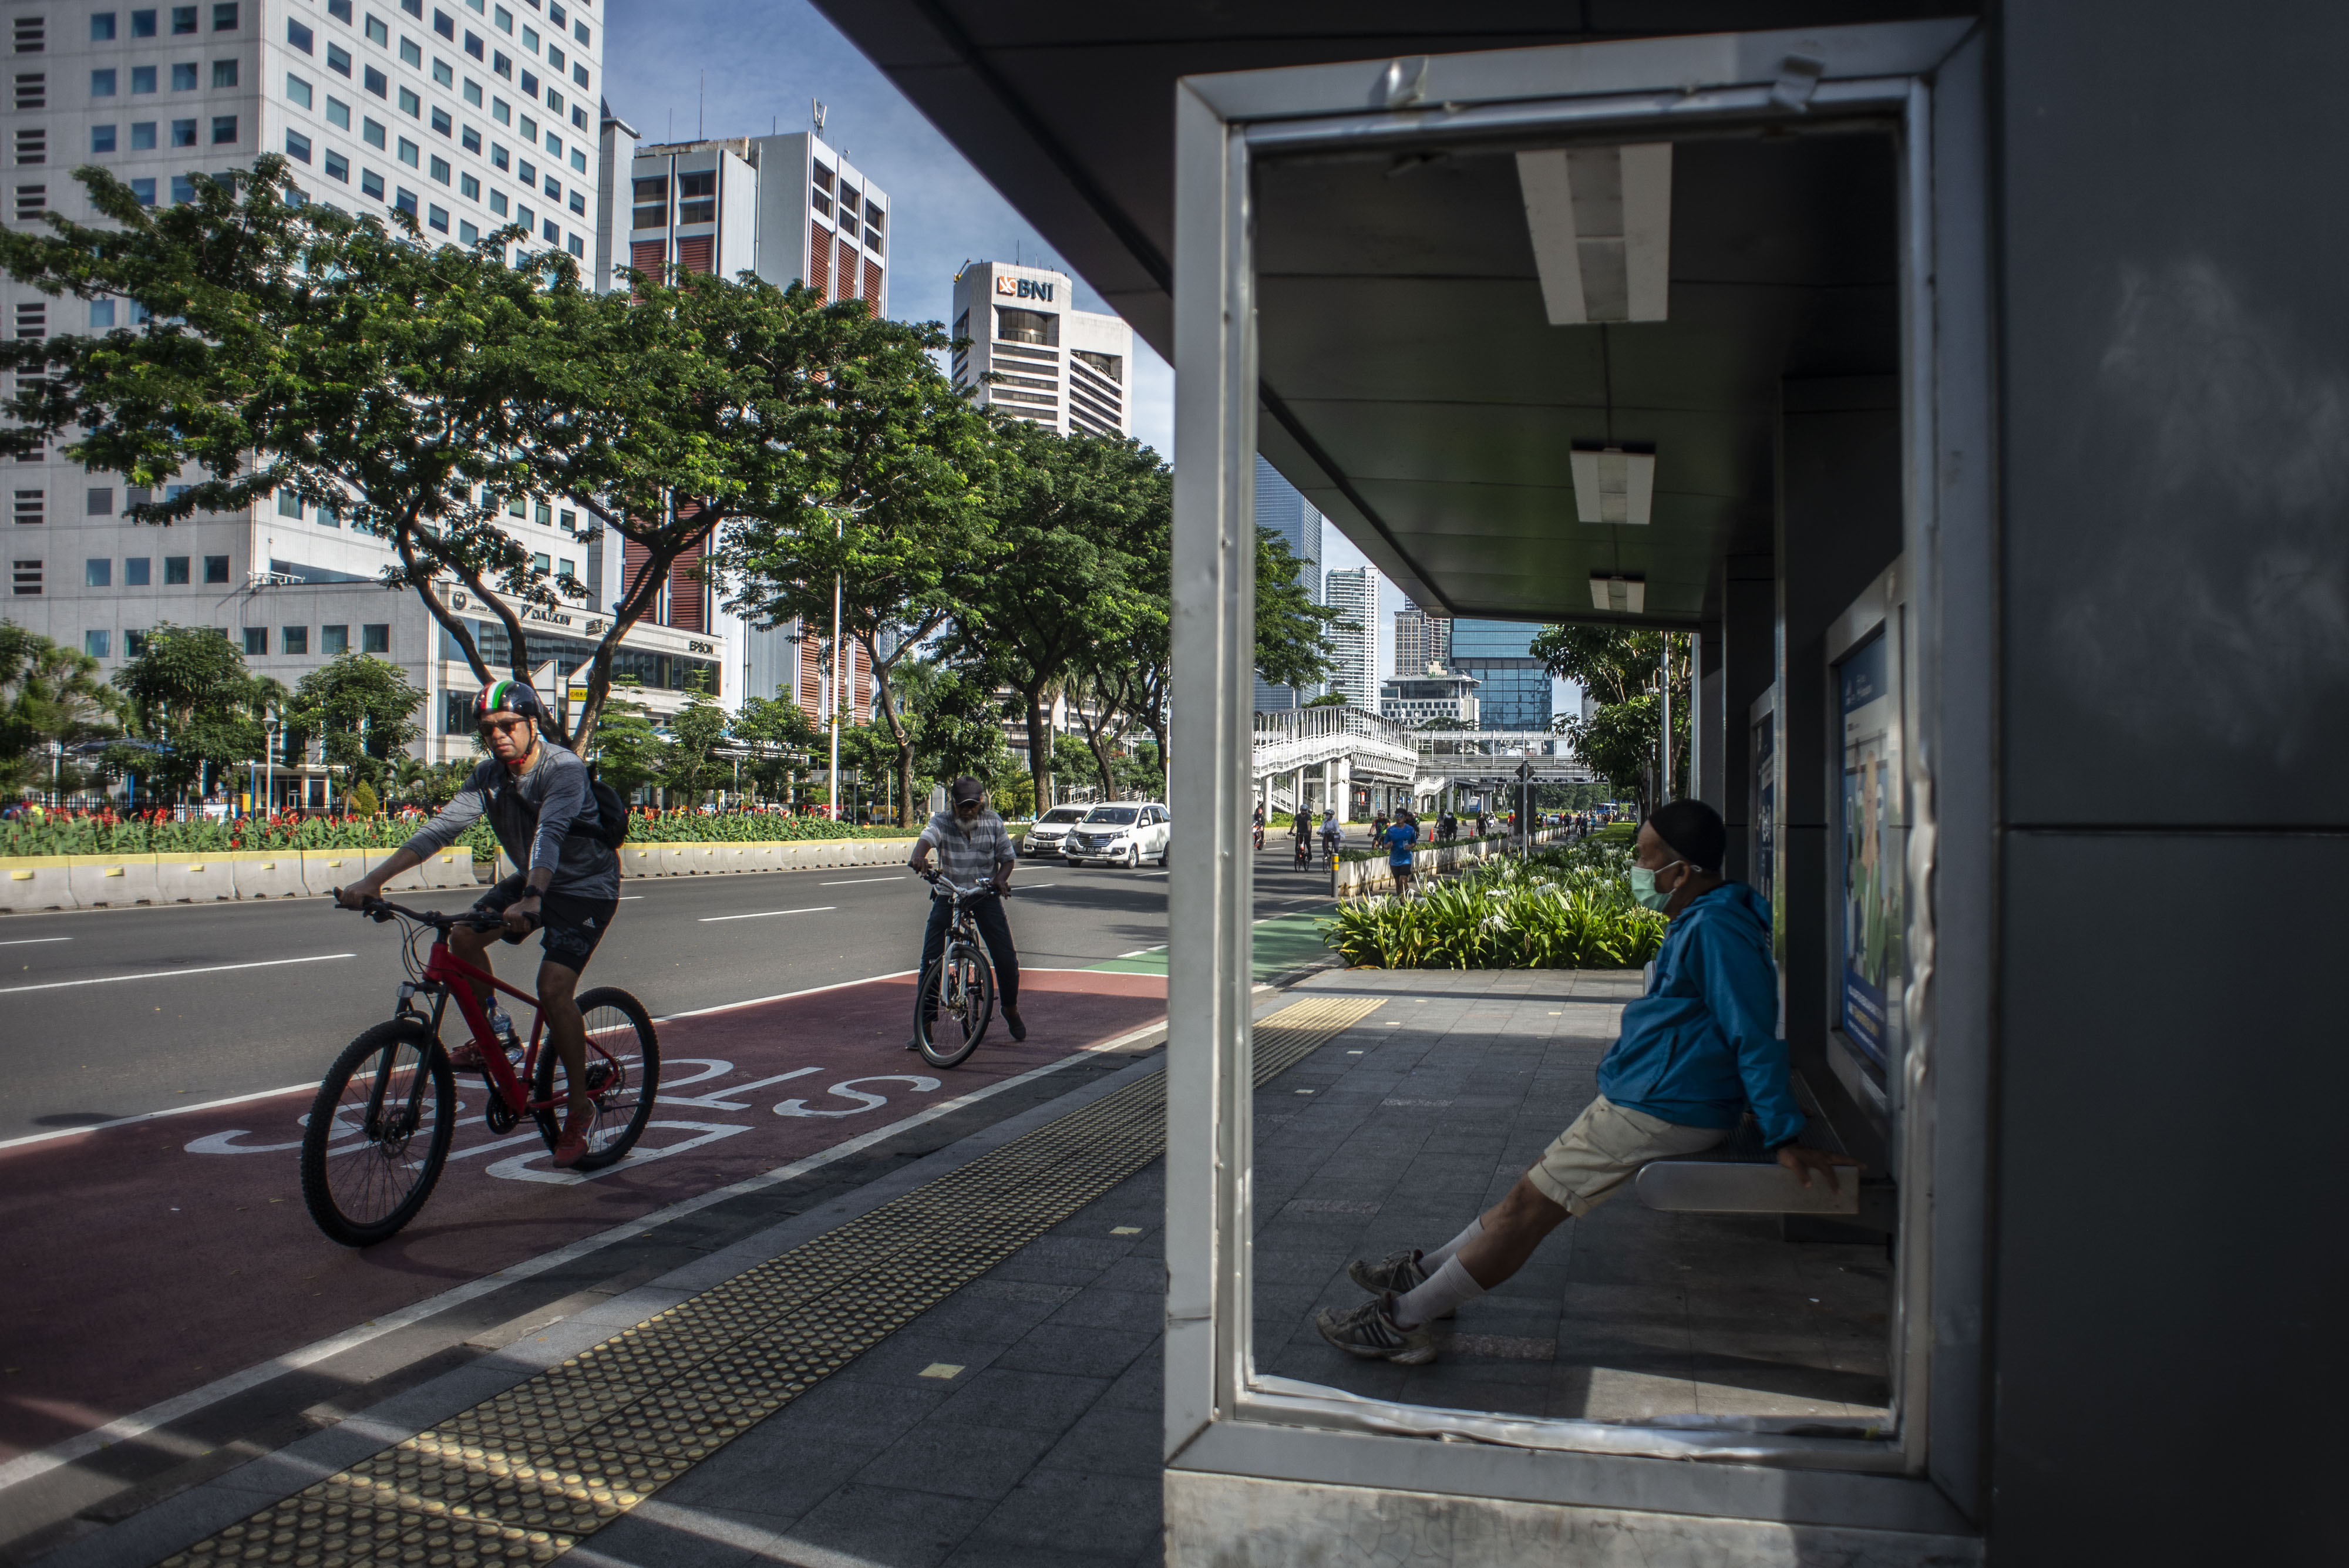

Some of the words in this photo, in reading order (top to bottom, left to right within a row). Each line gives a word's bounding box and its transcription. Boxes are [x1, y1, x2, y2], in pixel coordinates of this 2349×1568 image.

[1017, 278, 1054, 302] BNI
[531, 610, 571, 625] DAIKIN
[689, 640, 714, 654] EPSON
